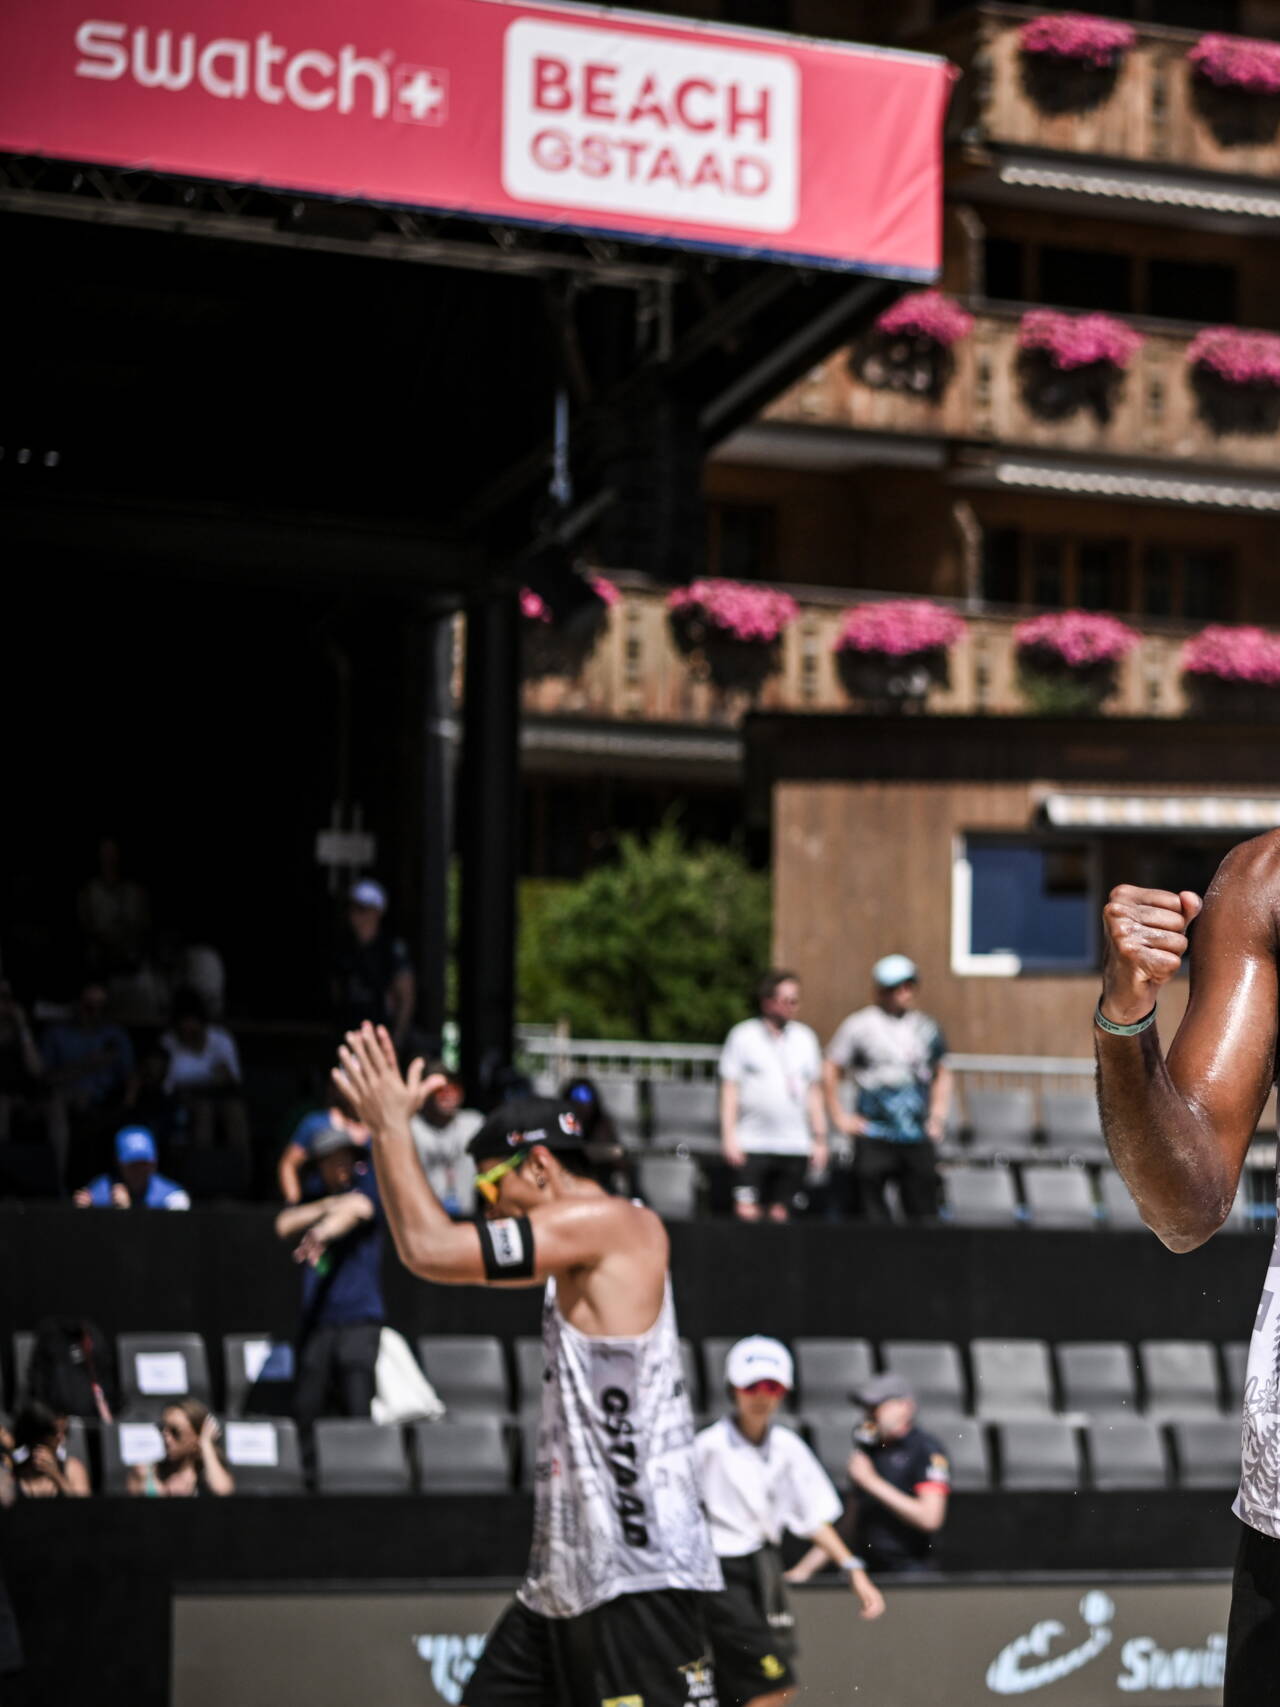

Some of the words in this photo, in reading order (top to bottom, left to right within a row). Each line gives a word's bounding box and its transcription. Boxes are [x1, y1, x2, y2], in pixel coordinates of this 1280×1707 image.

[75, 19, 391, 119] swatch
[532, 56, 771, 141] BEACH
[530, 127, 772, 198] GSTAAD
